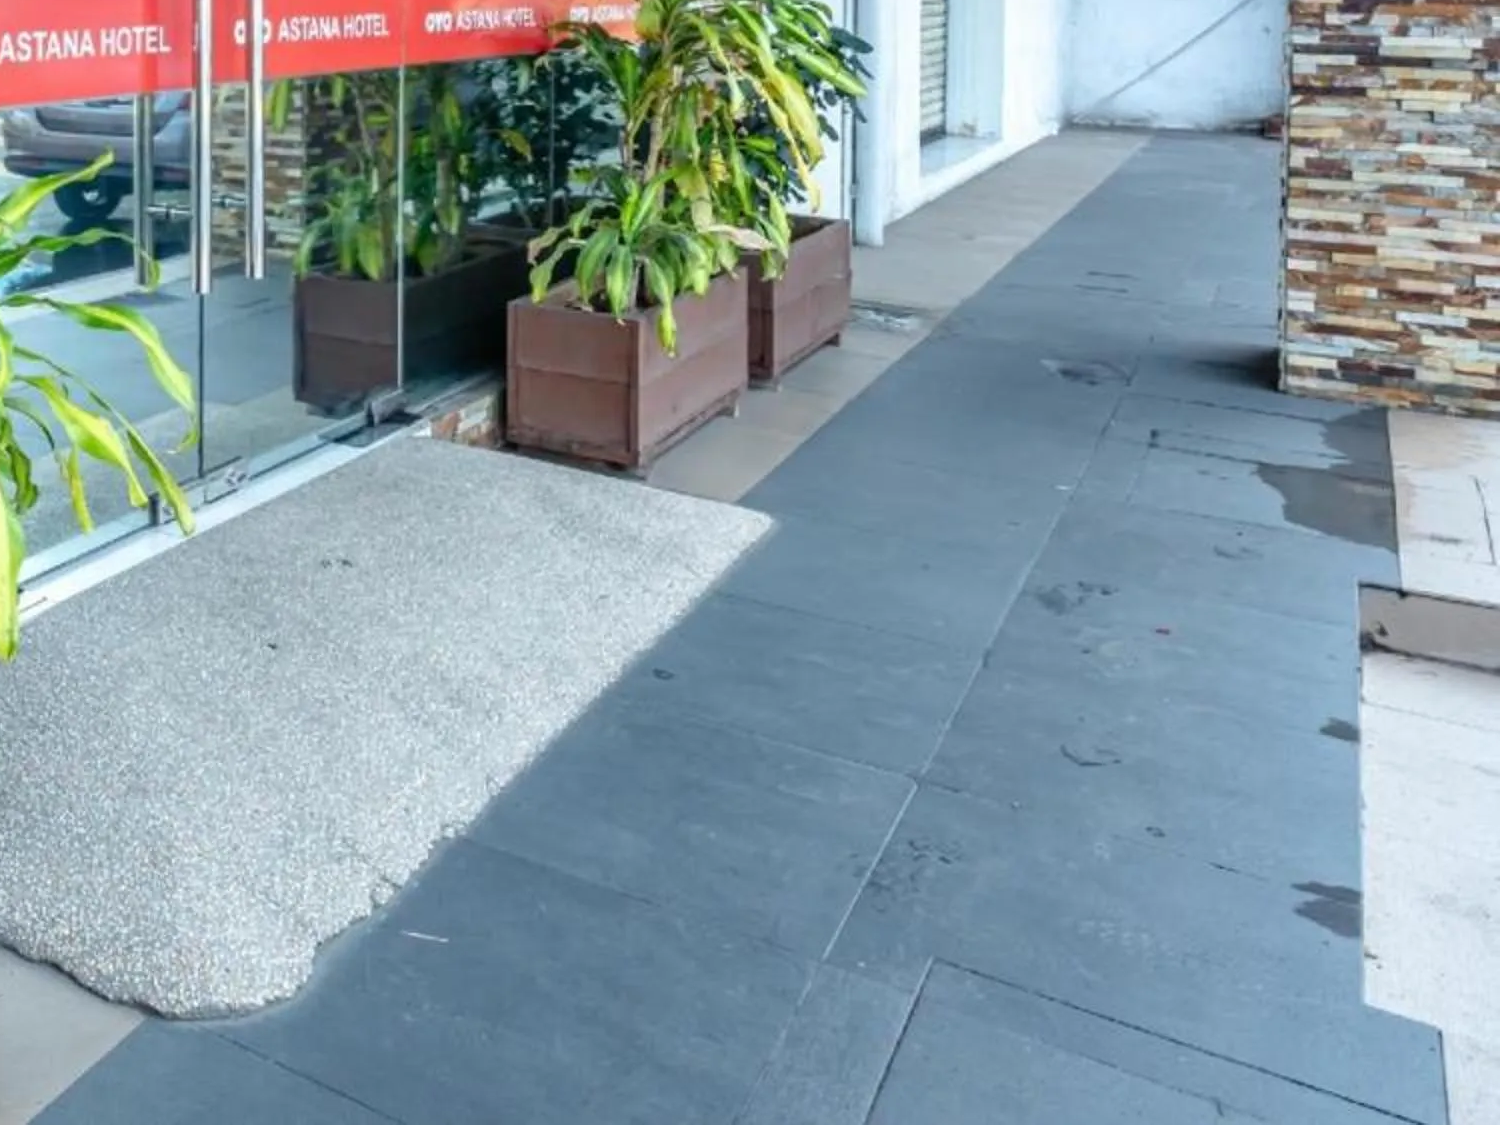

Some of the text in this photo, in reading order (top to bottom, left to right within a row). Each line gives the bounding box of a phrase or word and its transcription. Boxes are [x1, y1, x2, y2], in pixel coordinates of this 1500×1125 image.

[233, 11, 390, 45] OO ASTANA HOTEL
[424, 5, 537, 33] OYO ASTANA HOTEL
[100, 26, 172, 57] HOTEL
